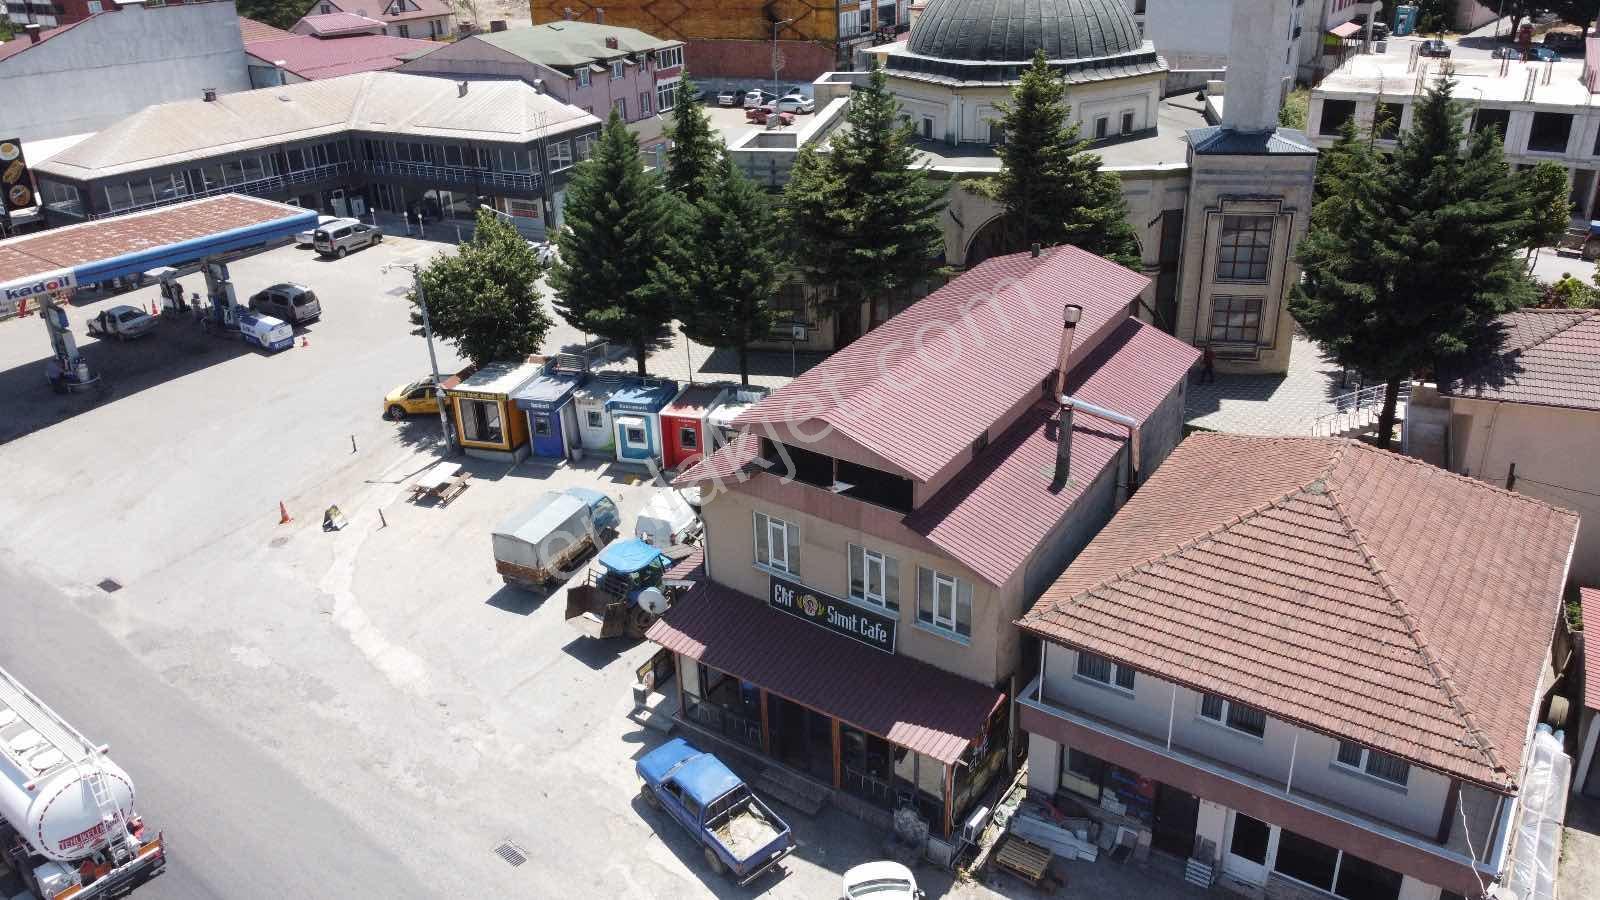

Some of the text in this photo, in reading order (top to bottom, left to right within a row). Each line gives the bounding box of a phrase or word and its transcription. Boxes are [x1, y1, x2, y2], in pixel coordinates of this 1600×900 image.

[5, 276, 70, 300] kadoil
[827, 605, 858, 633] Simit
[860, 617, 887, 643] Cafe
